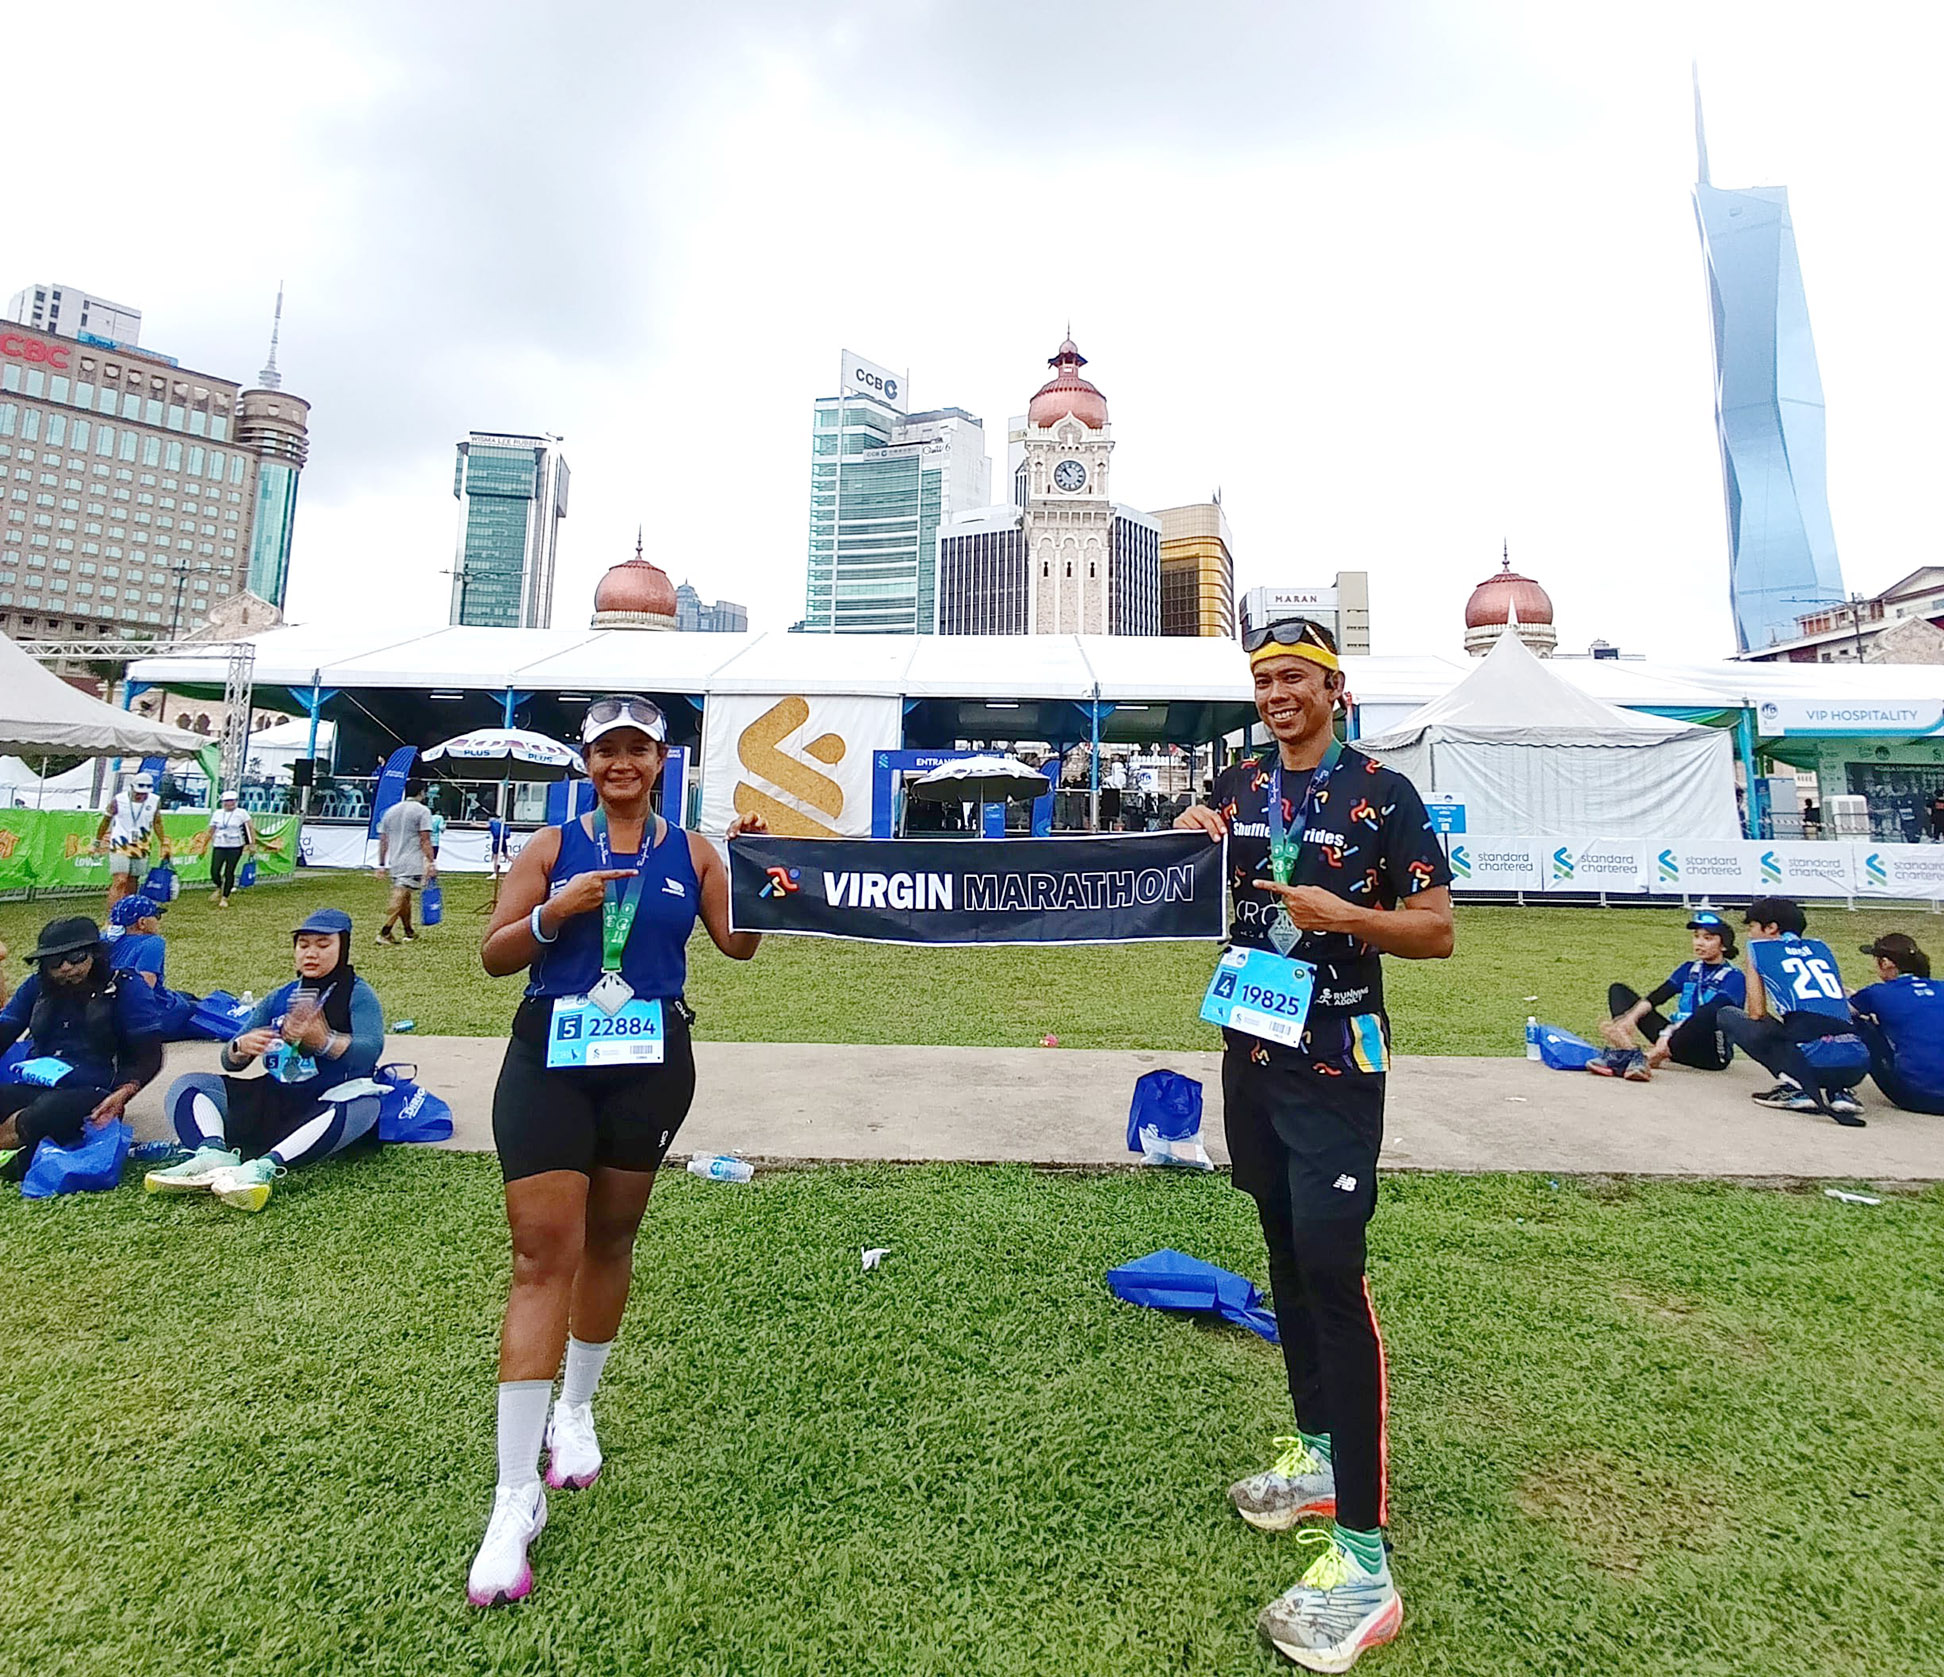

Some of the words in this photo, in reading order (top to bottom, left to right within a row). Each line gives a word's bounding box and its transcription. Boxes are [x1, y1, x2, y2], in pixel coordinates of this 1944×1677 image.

[856, 368, 883, 391] CCB
[471, 436, 496, 444] WISMA
[513, 439, 544, 447] RUBBER
[1806, 710, 1828, 721] VIP
[1831, 710, 1918, 721] HOSPITALITY
[528, 753, 554, 763] PLUS
[1478, 851, 1530, 862] standard
[1581, 854, 1634, 864] standard
[1686, 855, 1738, 866] standard
[1478, 862, 1533, 872] chartered
[1581, 863, 1638, 874] chartered
[1788, 858, 1841, 868] standard
[1686, 865, 1742, 876] chartered
[1788, 867, 1845, 878] chartered
[823, 869, 954, 910] VIRGIN
[963, 865, 1195, 911] MARATHON
[1781, 957, 1844, 1000] 26
[1219, 978, 1231, 996] 4
[1241, 984, 1300, 1016] 19825
[563, 1020, 576, 1038] 5
[588, 1017, 656, 1037] 22884
